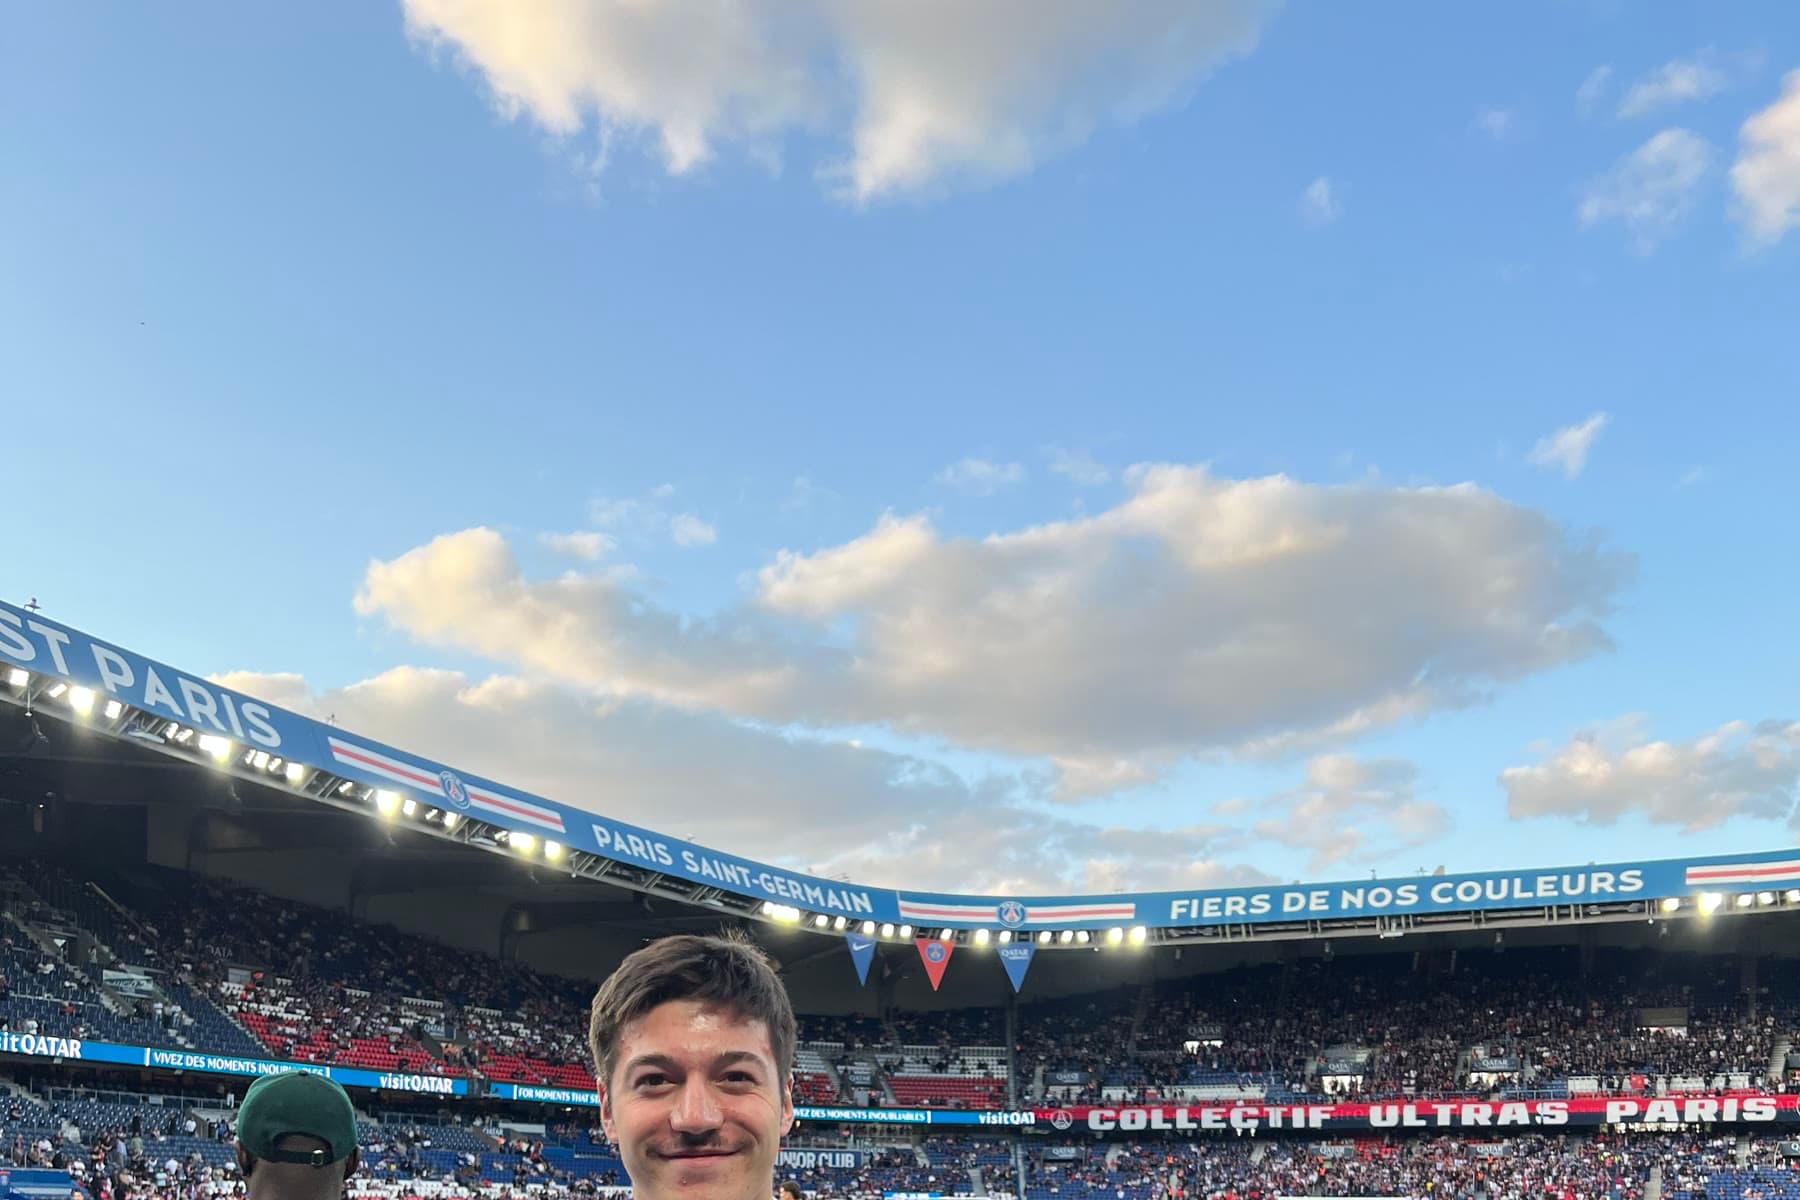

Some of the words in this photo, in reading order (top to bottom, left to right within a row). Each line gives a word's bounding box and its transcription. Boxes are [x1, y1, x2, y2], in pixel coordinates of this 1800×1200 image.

[90, 643, 282, 749] PARIS
[591, 823, 673, 867] PARIS
[681, 850, 874, 914] SAINT-GERMAIN
[1170, 894, 1272, 920] FIERS
[1282, 890, 1331, 913] DE
[1341, 884, 1419, 910] NOS
[1430, 869, 1645, 904] COULEURS
[1187, 1026, 1222, 1035] QATAR
[154, 1051, 183, 1066] VIVEZ
[185, 1055, 205, 1068] DES
[207, 1058, 257, 1073] MOMENTS
[1482, 1059, 1509, 1068] QATAR
[518, 1088, 534, 1098] FOR
[535, 1089, 571, 1101] MOMENTS
[571, 1092, 588, 1103] THAT
[1087, 1105, 1335, 1131] COLLECTIF
[1369, 1101, 1569, 1128] ULTRAS
[1606, 1098, 1777, 1124] PARIS
[1320, 1145, 1346, 1154] QATAR
[1477, 1145, 1504, 1154] QATAR
[818, 1152, 855, 1168] CLUB
